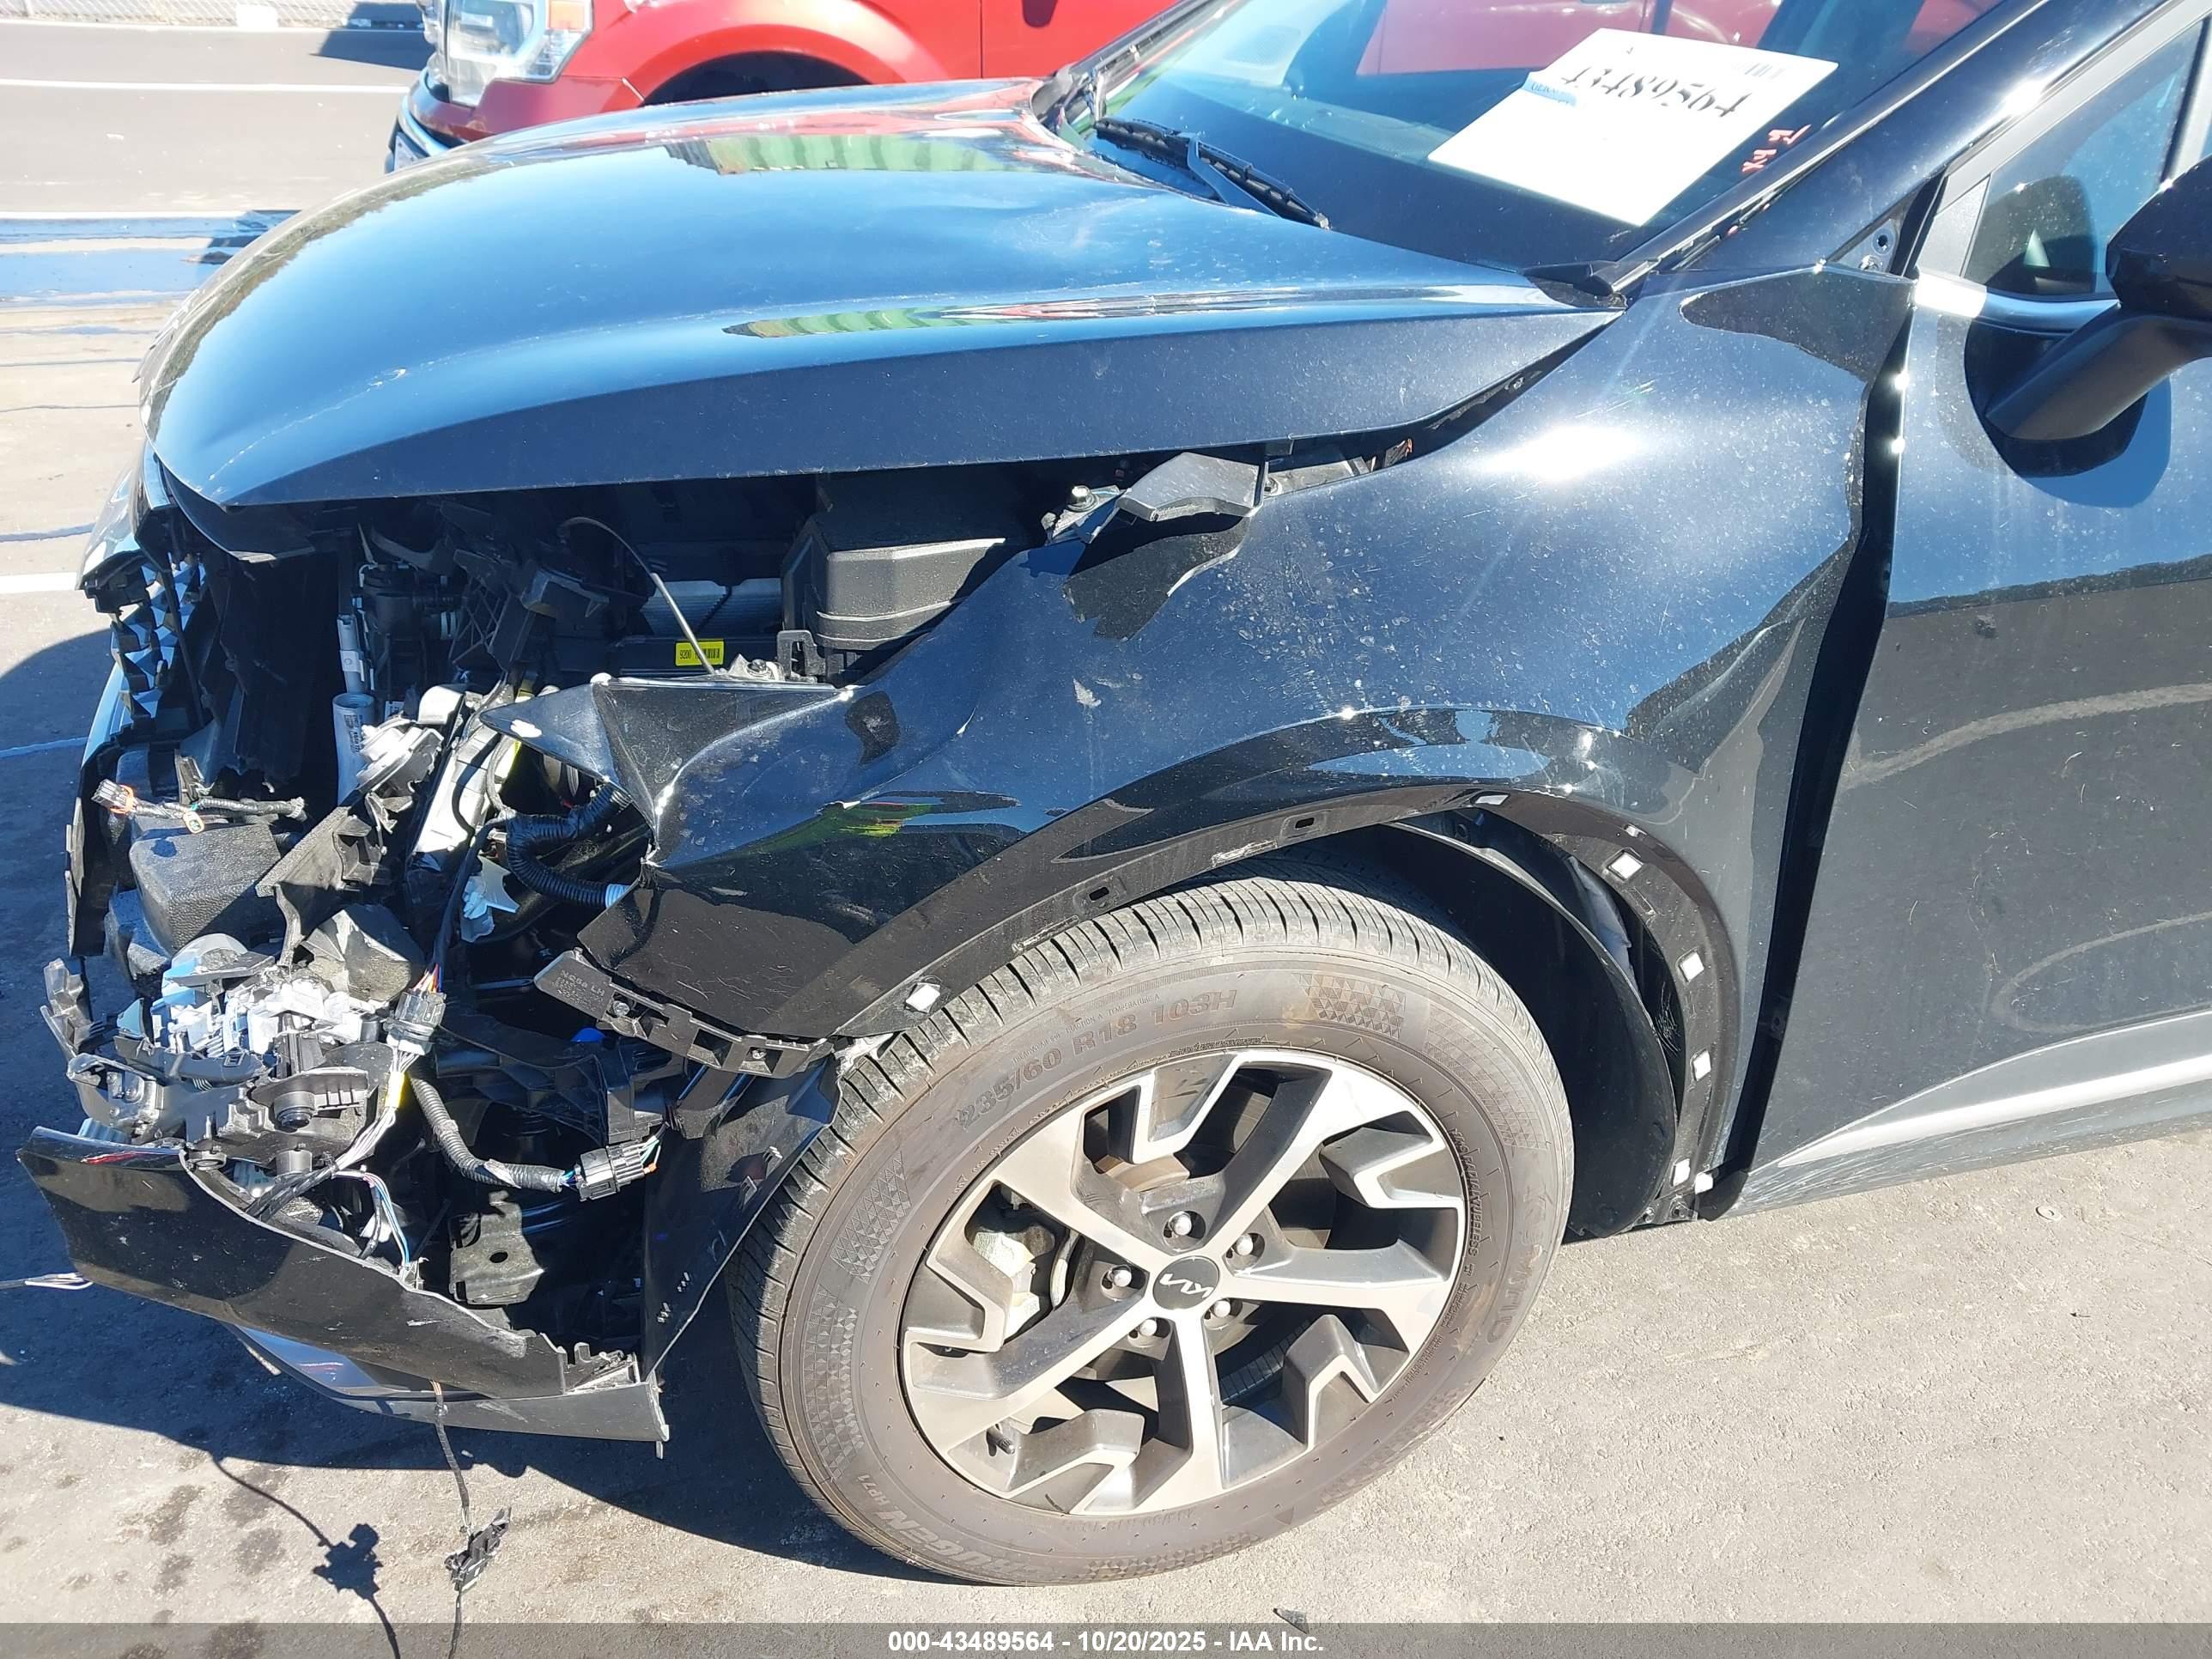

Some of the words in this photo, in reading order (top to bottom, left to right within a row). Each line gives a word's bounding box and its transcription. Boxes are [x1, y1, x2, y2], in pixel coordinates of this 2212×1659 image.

[1561, 66, 1753, 118] 43489564
[955, 1048, 1062, 1132] 235/60
[1073, 1013, 1138, 1057] R18
[1150, 989, 1237, 1025] 103H
[857, 1474, 892, 1506] HP71
